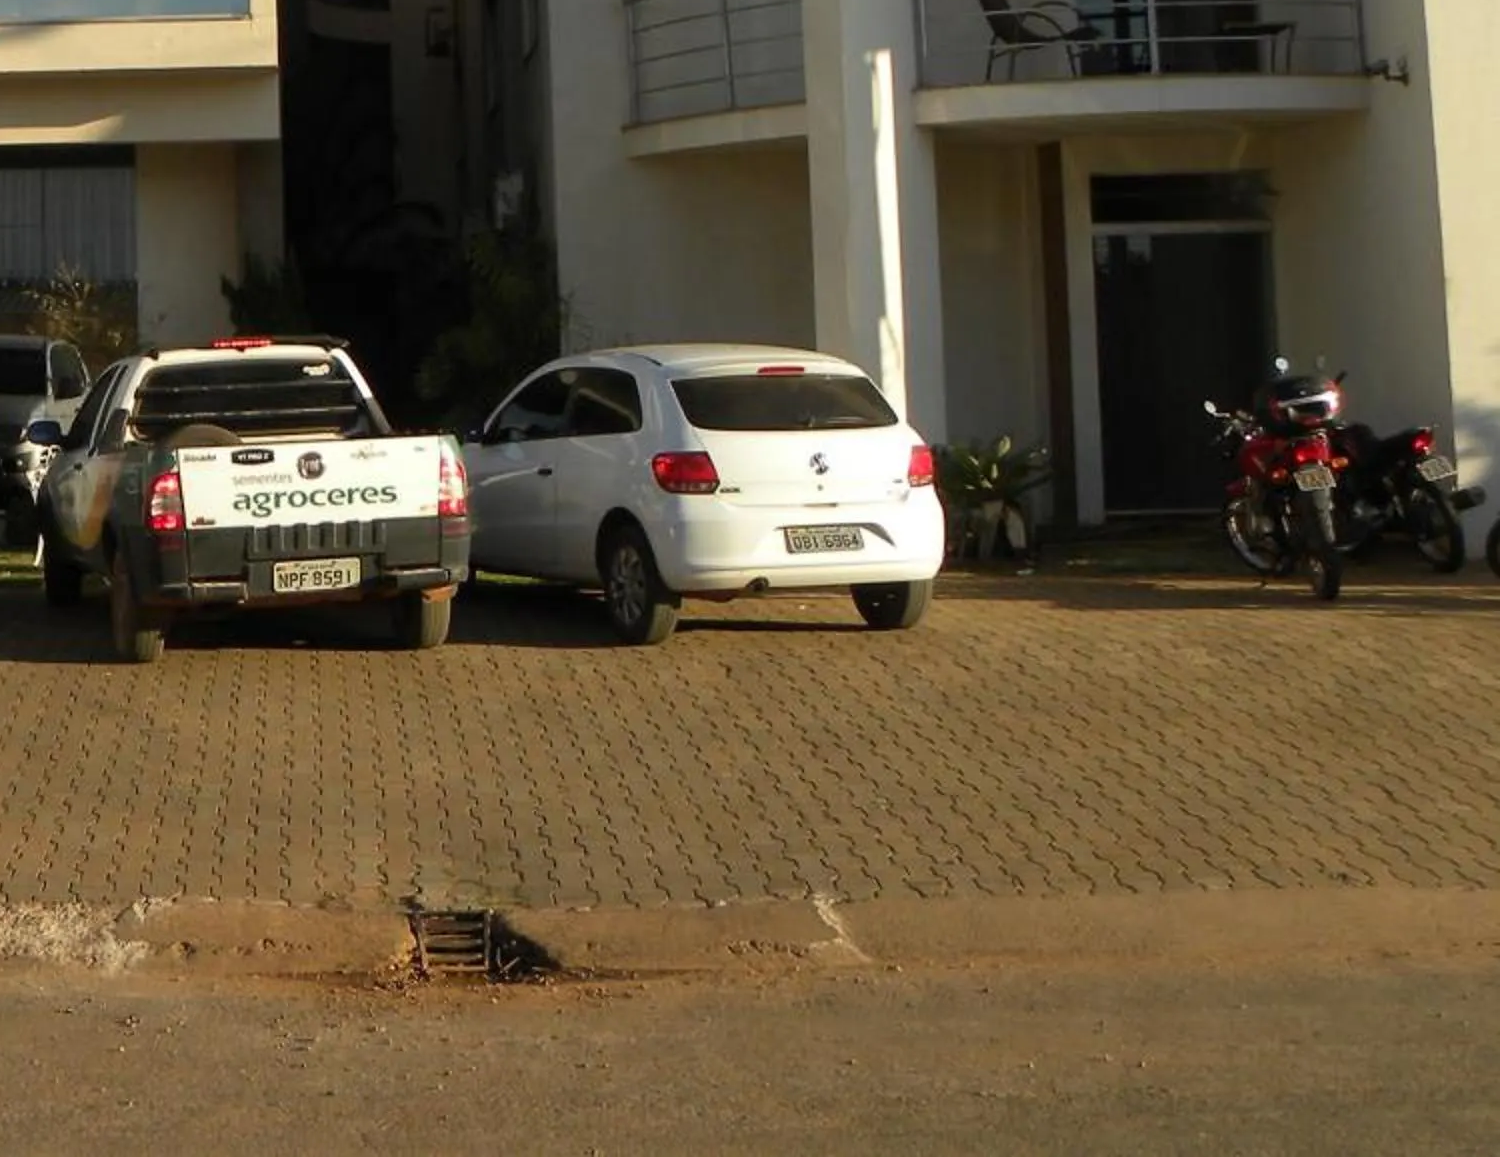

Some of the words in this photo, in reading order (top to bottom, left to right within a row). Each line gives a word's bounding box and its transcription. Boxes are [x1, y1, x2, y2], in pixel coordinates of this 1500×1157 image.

[233, 484, 398, 518] agroceres
[278, 572, 308, 588] NPF
[312, 569, 351, 587] 8591
